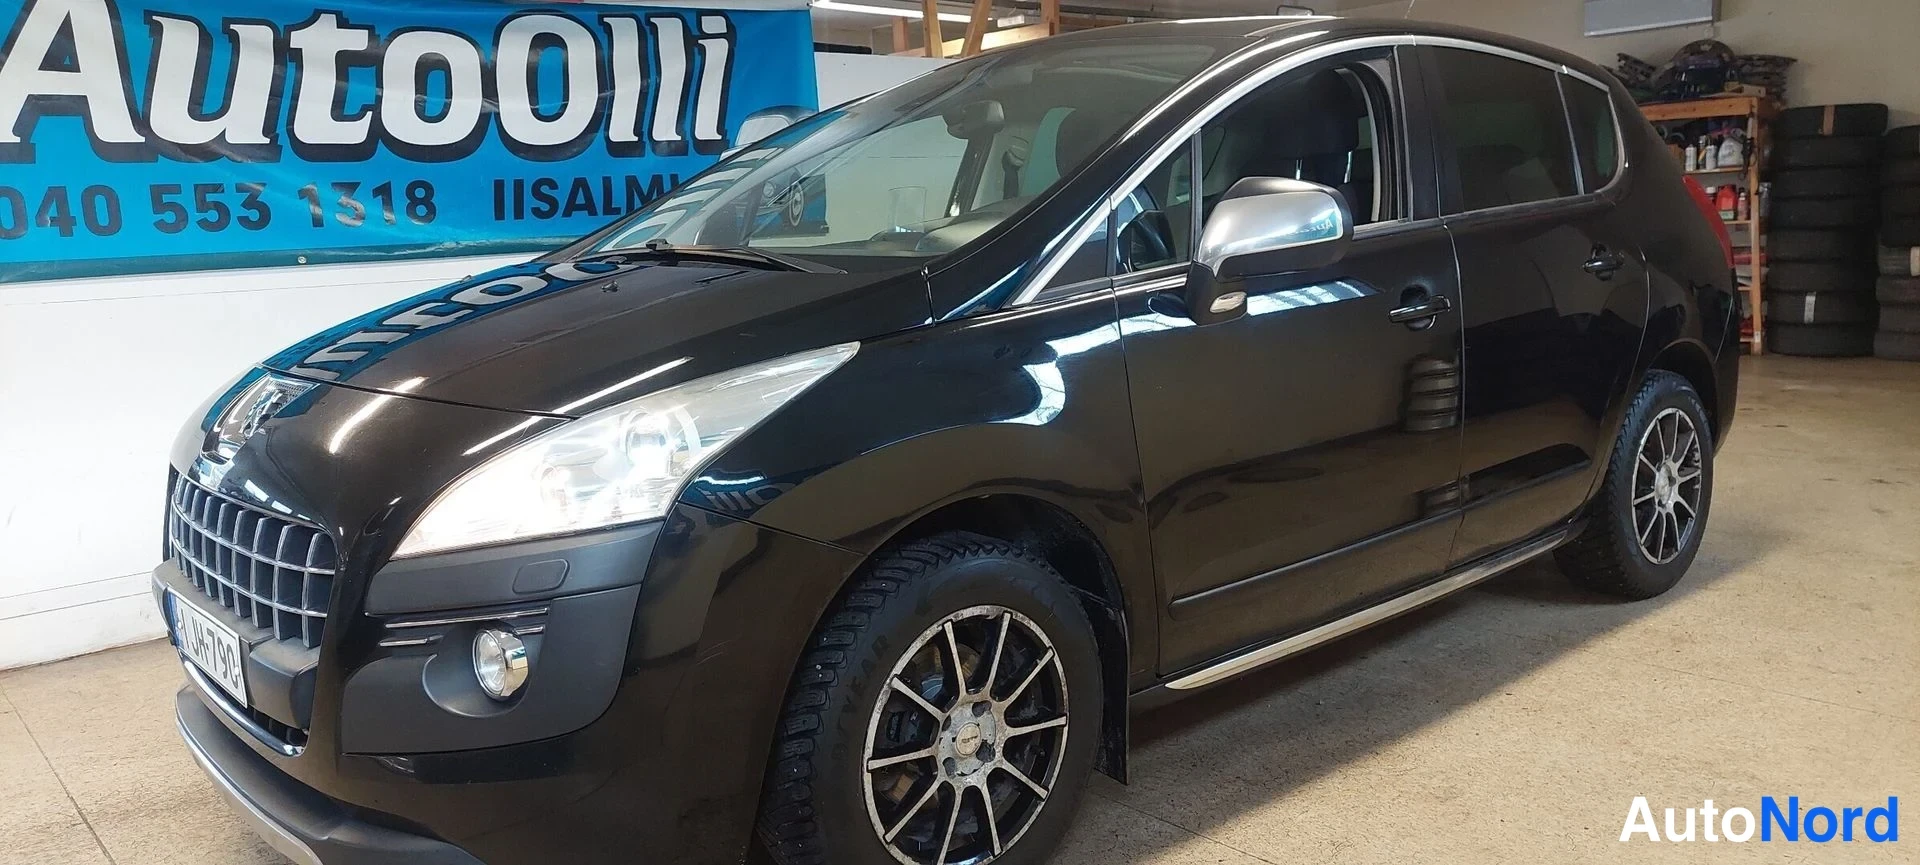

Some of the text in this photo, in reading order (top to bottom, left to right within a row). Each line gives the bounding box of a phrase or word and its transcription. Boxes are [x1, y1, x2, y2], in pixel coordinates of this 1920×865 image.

[0, 0, 733, 150] AutoOlli
[0, 184, 123, 240] 040
[150, 182, 272, 234] 553
[297, 179, 437, 228] 1318
